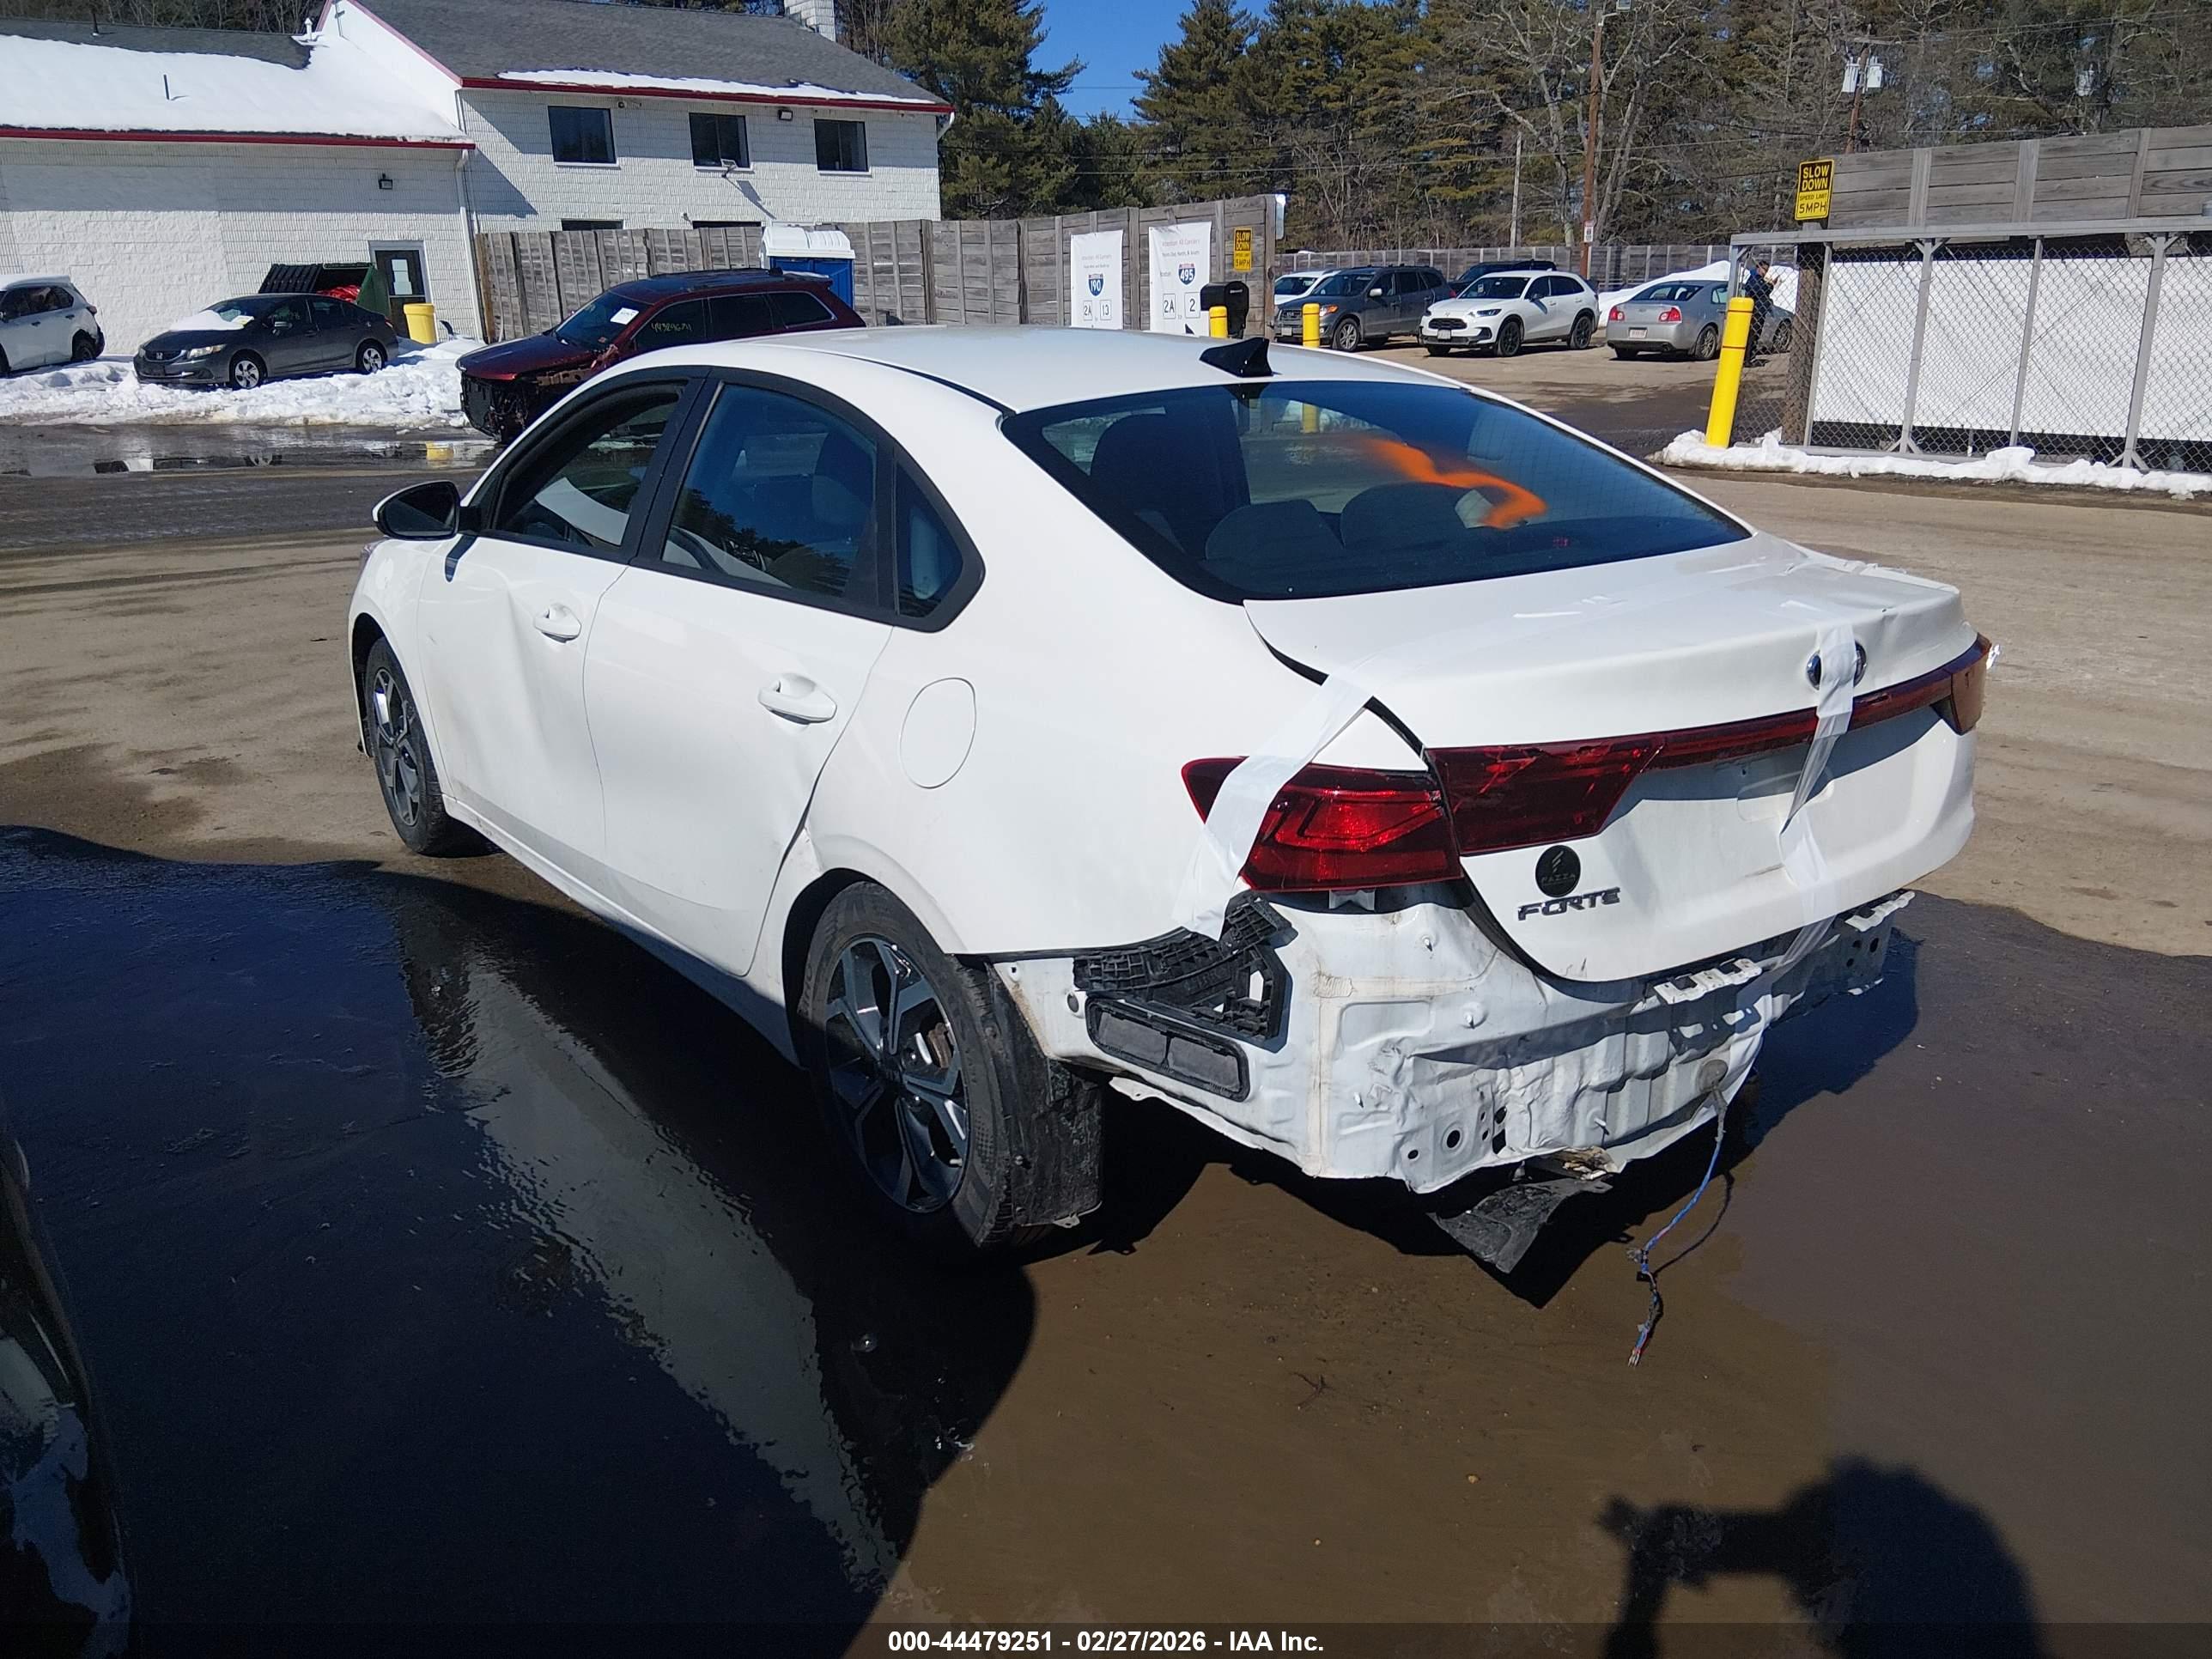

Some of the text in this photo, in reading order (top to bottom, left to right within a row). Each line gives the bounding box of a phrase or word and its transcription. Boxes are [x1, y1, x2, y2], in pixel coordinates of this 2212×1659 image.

[1802, 164, 1829, 179] SLOW
[1802, 178, 1828, 191] DOWN
[1799, 201, 1826, 214] 5MPH
[1237, 232, 1250, 241] SLOW
[1237, 241, 1250, 251] DOWN
[1180, 268, 1194, 282] 495
[1090, 279, 1102, 292] 190
[1084, 304, 1109, 316] 2A 13
[1164, 298, 1195, 313] 2A 2
[1517, 887, 1620, 921] FORTE
